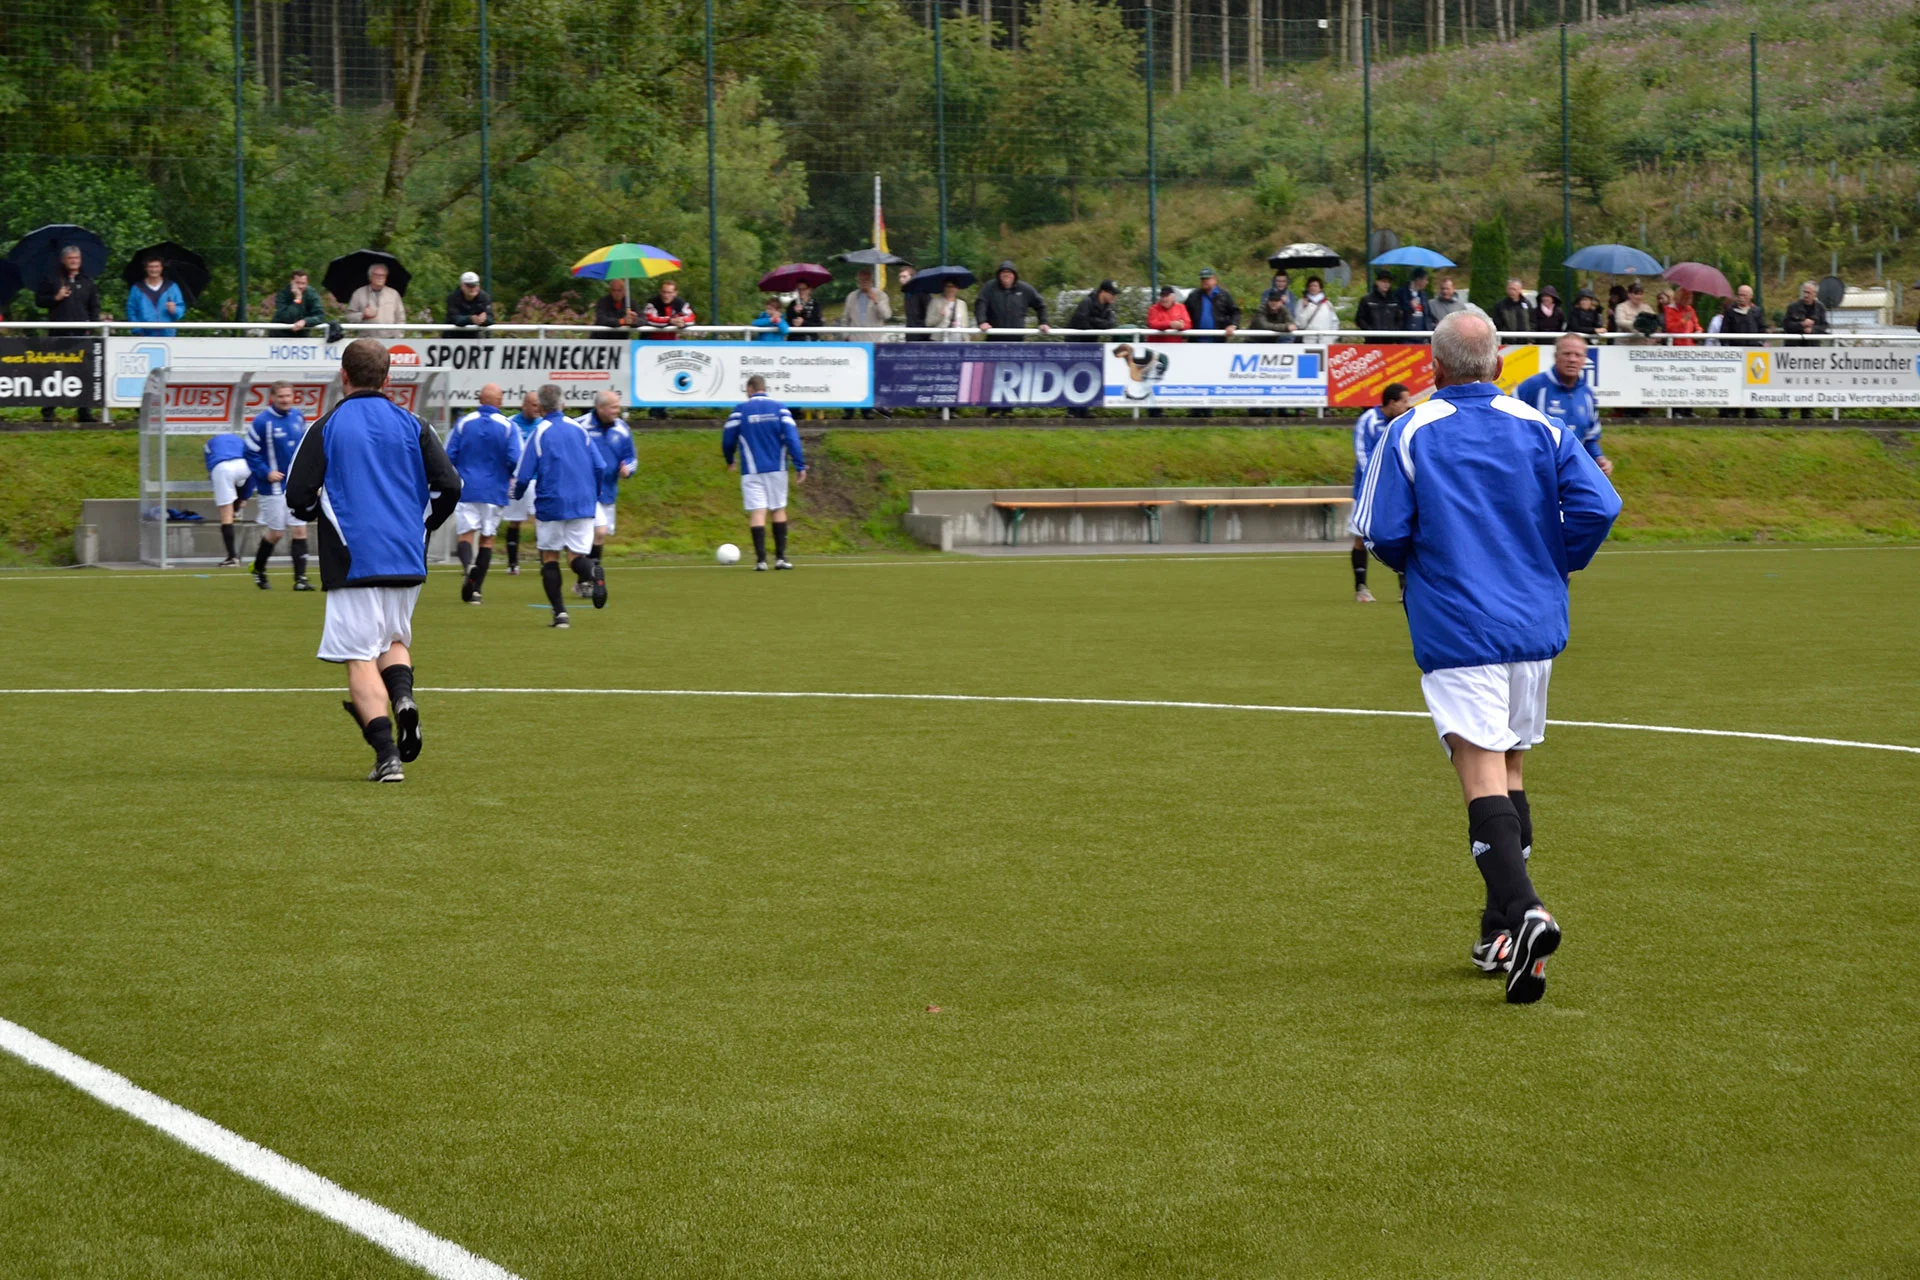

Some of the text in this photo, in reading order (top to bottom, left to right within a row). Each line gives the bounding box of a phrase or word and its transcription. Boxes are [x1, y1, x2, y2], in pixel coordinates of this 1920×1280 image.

[270, 345, 318, 360] HORST
[390, 353, 417, 365] PORT
[425, 344, 622, 370] SPORT HENNECKEN
[1328, 347, 1358, 368] neon
[1629, 348, 1743, 359] ERDWÄRMEBOHRUNGEN
[740, 355, 850, 366] Brillen Contactlinsen
[1774, 352, 1912, 370] Werner Schumacher
[783, 383, 831, 393] Schmuck
[991, 360, 1102, 405] RIDO
[245, 384, 318, 406] SBS
[1750, 392, 1790, 403] Renault
[1794, 392, 1814, 403] und
[1817, 392, 1847, 403] Dacia
